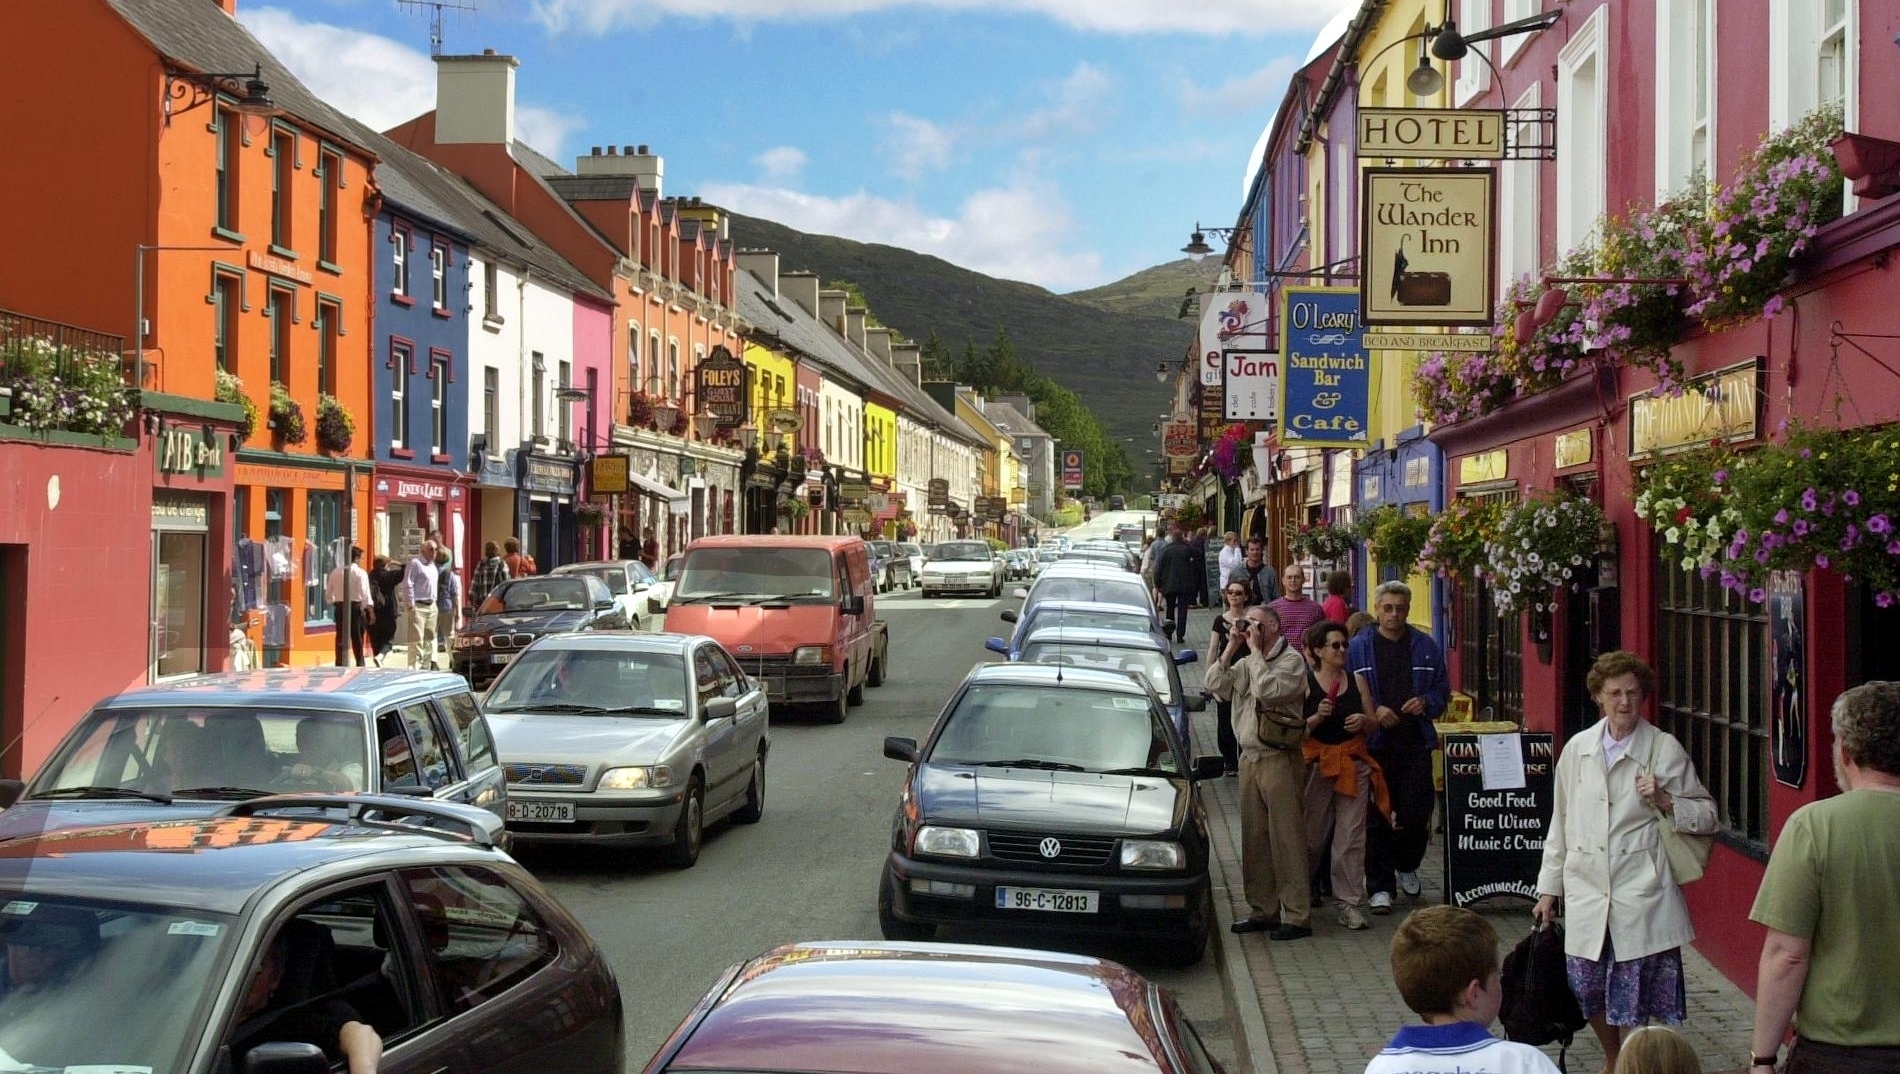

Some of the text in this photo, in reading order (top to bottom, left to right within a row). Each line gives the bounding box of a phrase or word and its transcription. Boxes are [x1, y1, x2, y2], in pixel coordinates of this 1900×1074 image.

[1364, 117, 1493, 145] HOTEL
[1400, 181, 1443, 203] The
[1420, 229, 1460, 253] Inn
[1230, 356, 1278, 378] Jam
[1291, 352, 1364, 370] Sandwich
[702, 369, 741, 386] FOLEYS
[1313, 369, 1341, 386] Bar
[1312, 392, 1342, 409] &
[164, 431, 192, 470] AIB
[424, 483, 444, 499] LACE
[1446, 742, 1553, 758] WAN INN
[1468, 792, 1537, 808] Good Food
[508, 804, 568, 819] 8-D-20718
[1464, 813, 1542, 830] Fine Wines
[1458, 834, 1501, 850] Music
[1503, 836, 1512, 850] &
[1016, 892, 1088, 911] 96-C-12813
